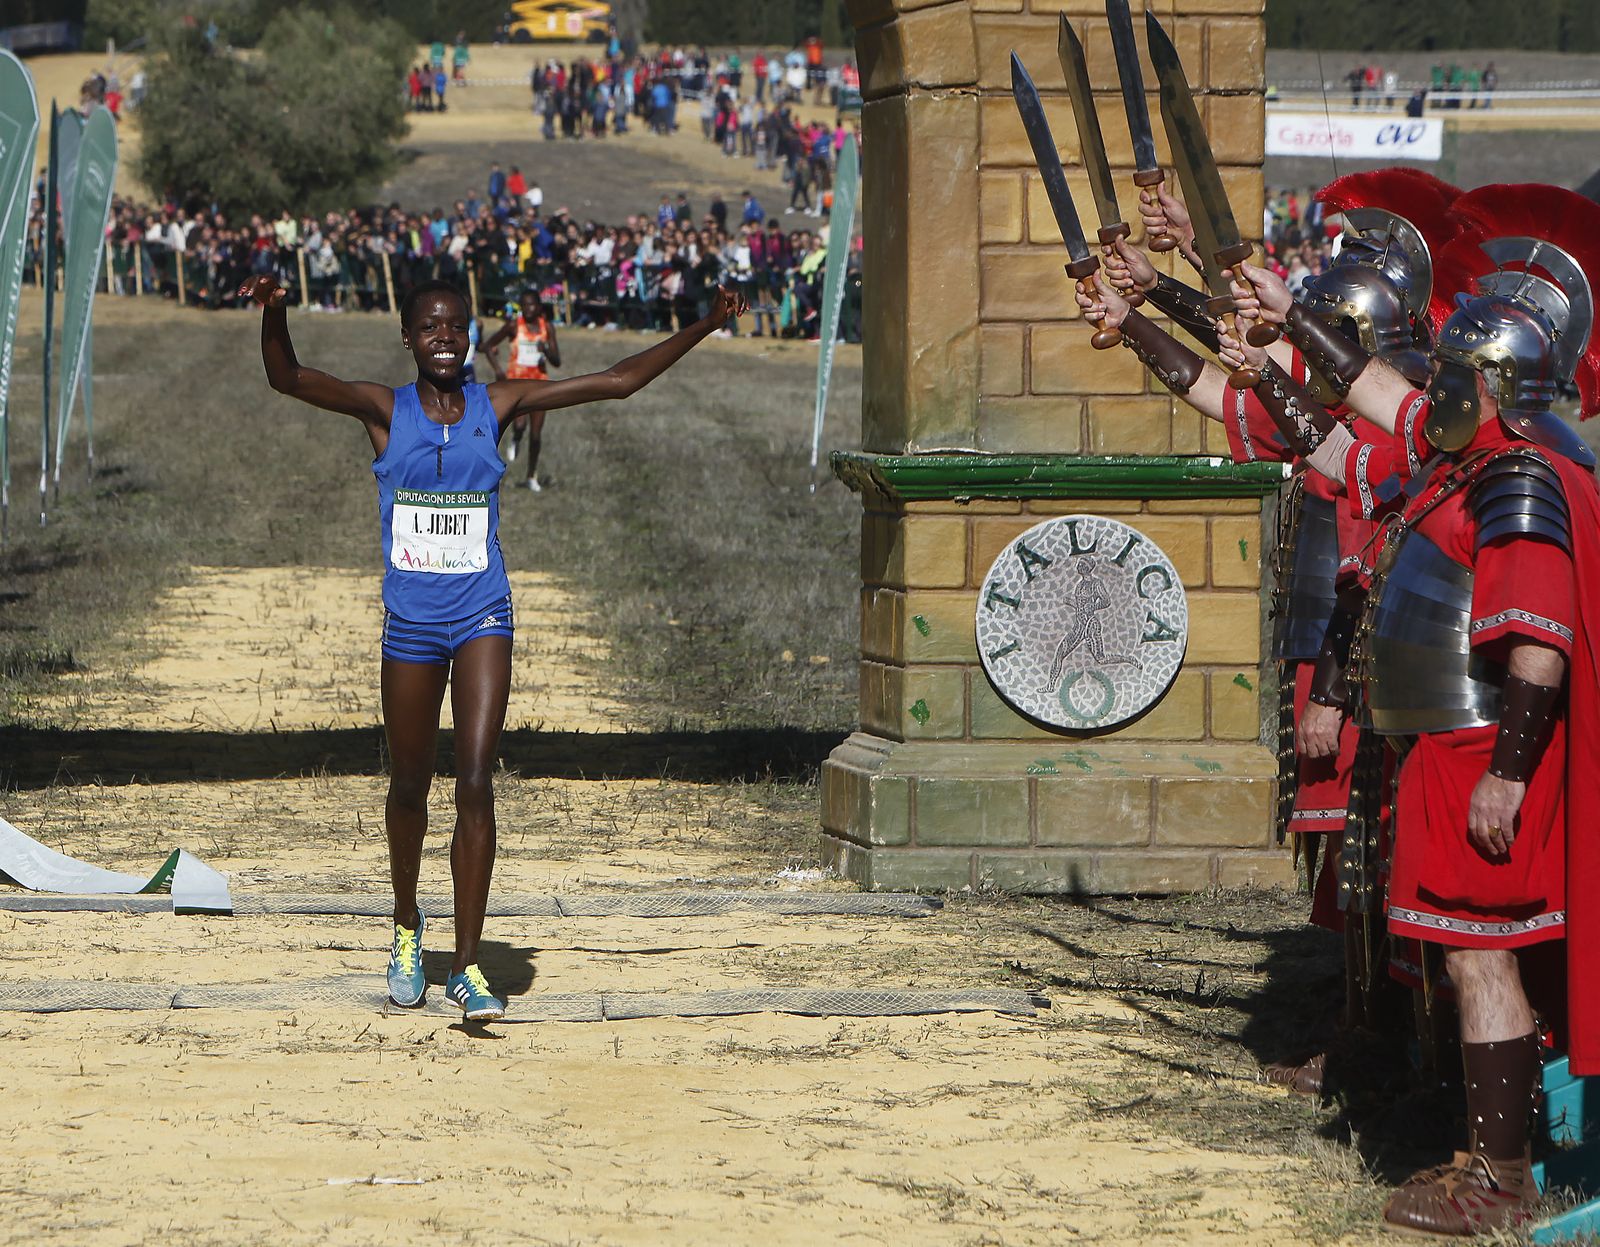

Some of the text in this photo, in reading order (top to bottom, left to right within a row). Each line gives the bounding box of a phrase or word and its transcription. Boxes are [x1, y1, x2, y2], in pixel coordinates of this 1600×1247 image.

[397, 491, 486, 505] DIPUTACION DE SEVILLA
[426, 513, 470, 536] JEBET
[399, 547, 481, 570] Andalucía
[985, 519, 1179, 664] ITALICA
